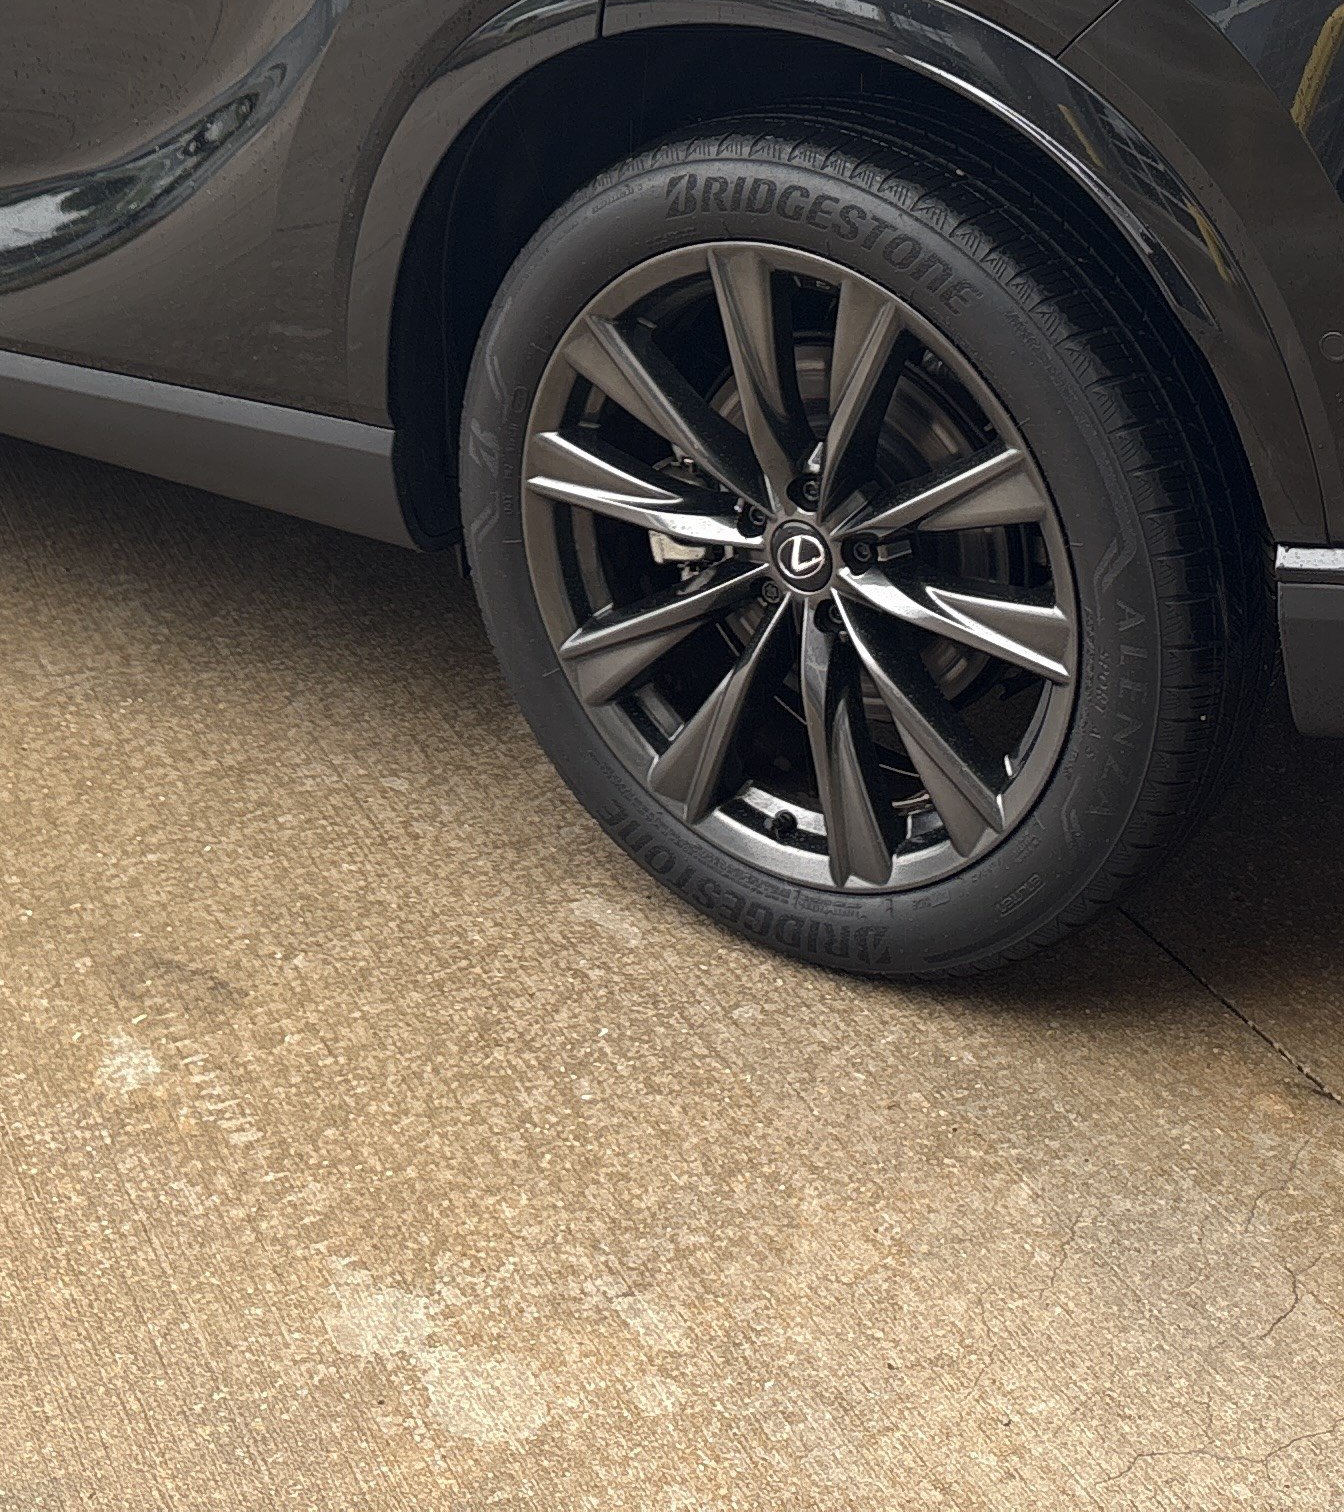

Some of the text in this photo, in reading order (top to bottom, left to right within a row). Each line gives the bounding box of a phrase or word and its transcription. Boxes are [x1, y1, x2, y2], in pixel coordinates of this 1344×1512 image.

[664, 172, 984, 317] BRIDGESTONE
[1085, 598, 1148, 816] ALENZA
[595, 798, 894, 966] BRIDGESTONE
